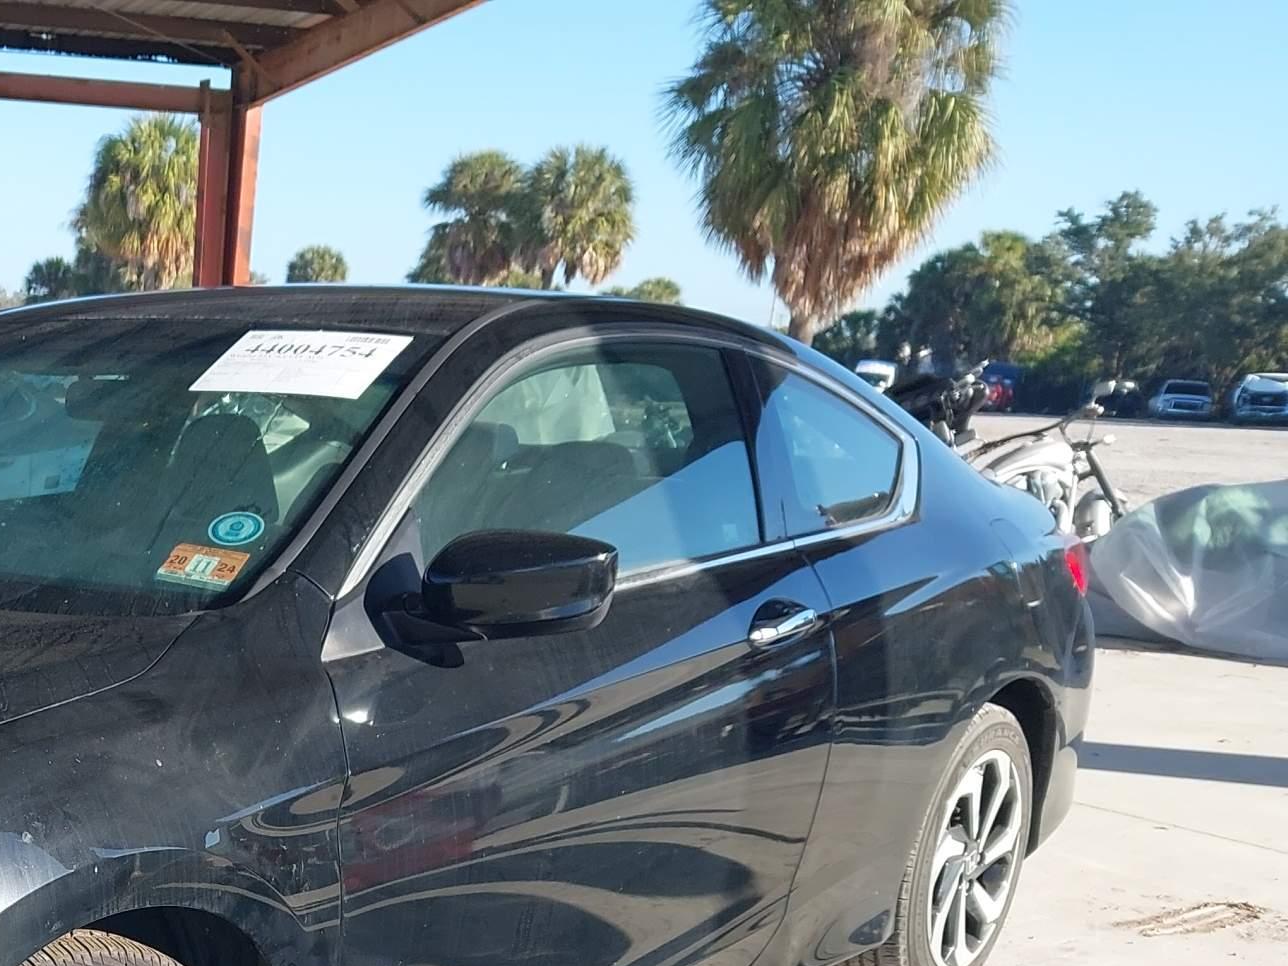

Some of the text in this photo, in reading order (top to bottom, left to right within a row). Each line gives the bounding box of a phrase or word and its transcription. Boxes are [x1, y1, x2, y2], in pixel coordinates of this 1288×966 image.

[245, 343, 378, 358] 44004754
[168, 554, 188, 565] 20
[191, 559, 212, 573] 11
[217, 563, 236, 574] 24
